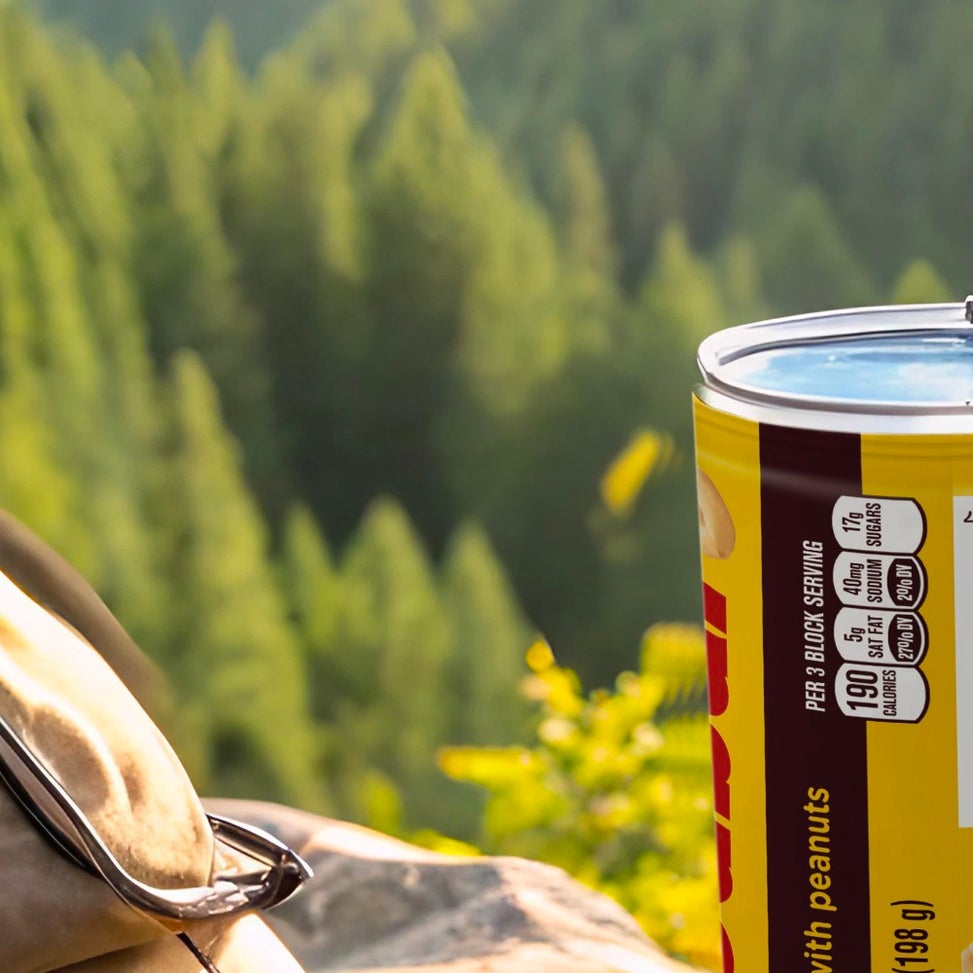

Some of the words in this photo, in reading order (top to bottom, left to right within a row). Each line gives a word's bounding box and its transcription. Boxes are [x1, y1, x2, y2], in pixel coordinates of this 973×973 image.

[842, 513, 863, 533] 17g
[866, 503, 881, 547] SUGARS
[802, 540, 823, 607] SERVING
[843, 563, 864, 595] 40mg
[867, 559, 882, 603] SODIUM
[803, 611, 824, 662] BLOCK
[844, 628, 865, 642] 5g
[867, 615, 883, 635] FAT
[868, 638, 883, 658] SAT
[806, 667, 825, 677] 3
[805, 681, 825, 712] PER
[846, 670, 878, 711] 190
[883, 670, 897, 716] CALORIES
[803, 787, 837, 912] peanuts
[890, 900, 935, 921] g)
